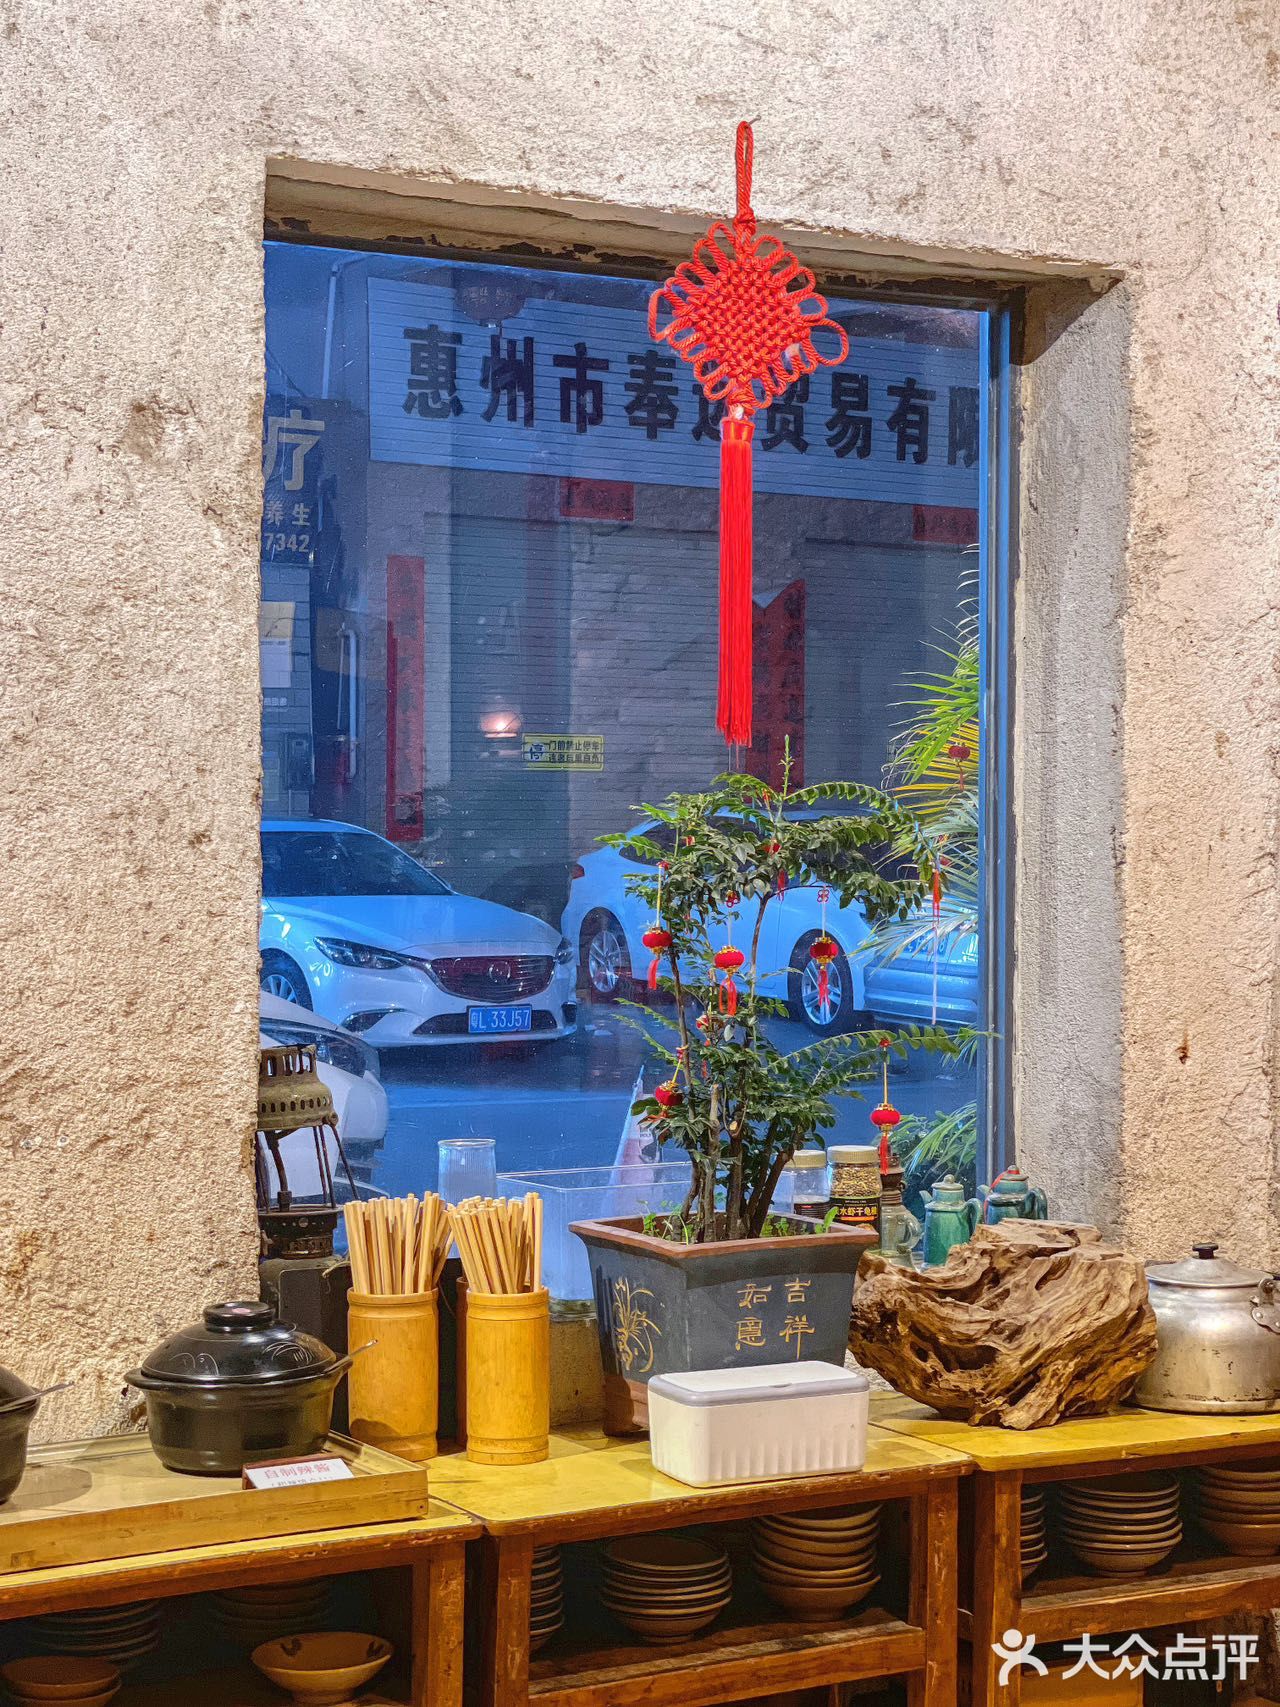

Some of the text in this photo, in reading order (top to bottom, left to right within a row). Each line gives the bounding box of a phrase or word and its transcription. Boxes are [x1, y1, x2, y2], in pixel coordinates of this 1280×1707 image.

[264, 409, 325, 491] 疗
[265, 532, 310, 553] 7342
[549, 740, 600, 751] 门前禁止停车
[837, 1206, 878, 1217] 水虾干龟粮
[735, 1283, 772, 1351] 如意
[779, 1277, 816, 1361] 吉祥
